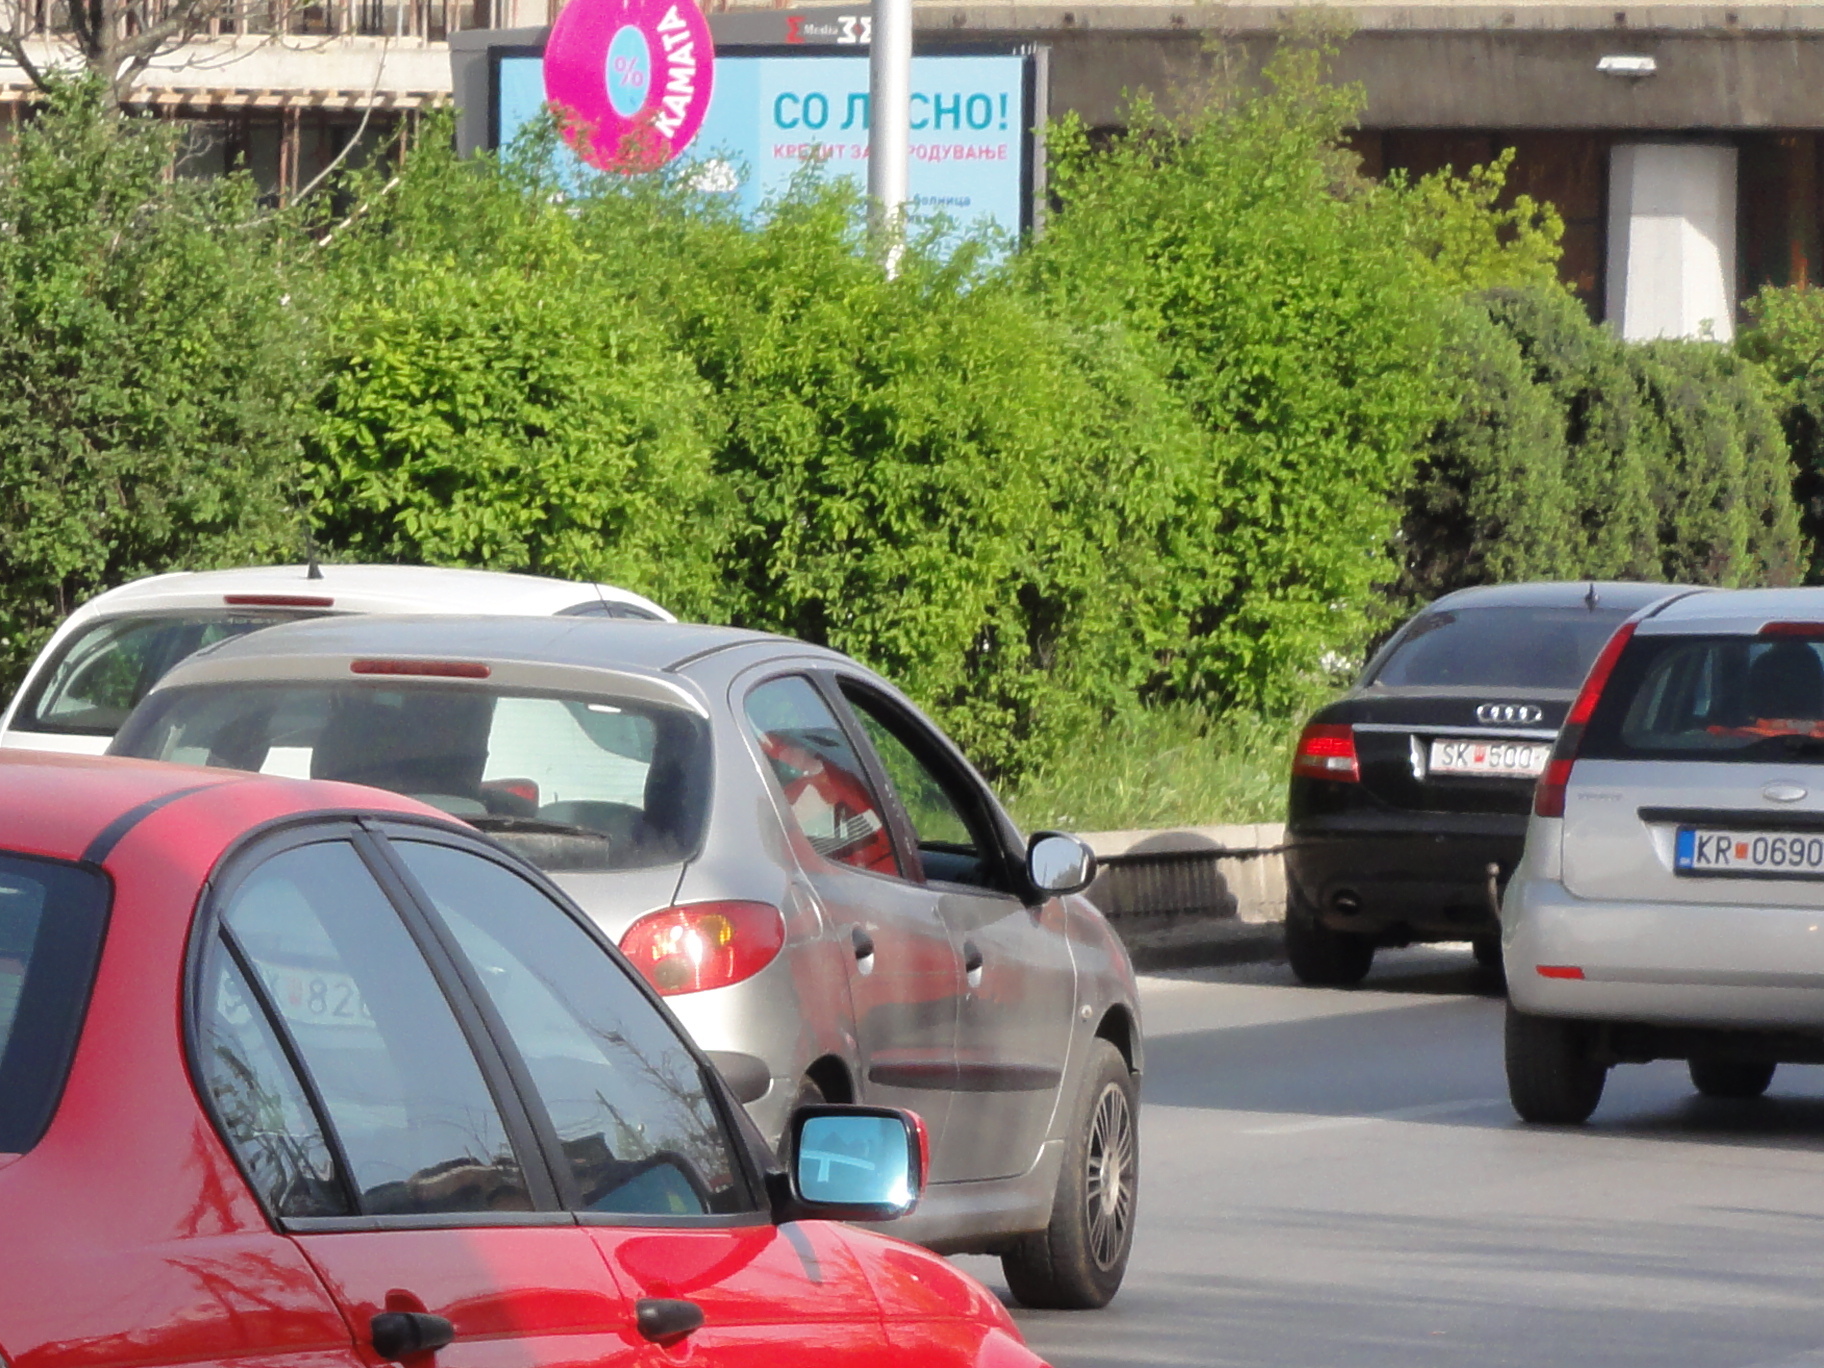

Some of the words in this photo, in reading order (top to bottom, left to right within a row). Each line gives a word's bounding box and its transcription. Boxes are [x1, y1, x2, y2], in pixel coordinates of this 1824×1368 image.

[655, 5, 697, 139] КАМАТА
[773, 91, 829, 130] СО
[840, 91, 1009, 130] ЛСНО!
[1441, 742, 1470, 767] SK
[1695, 835, 1732, 865] KR
[1752, 837, 1824, 867] 0690
